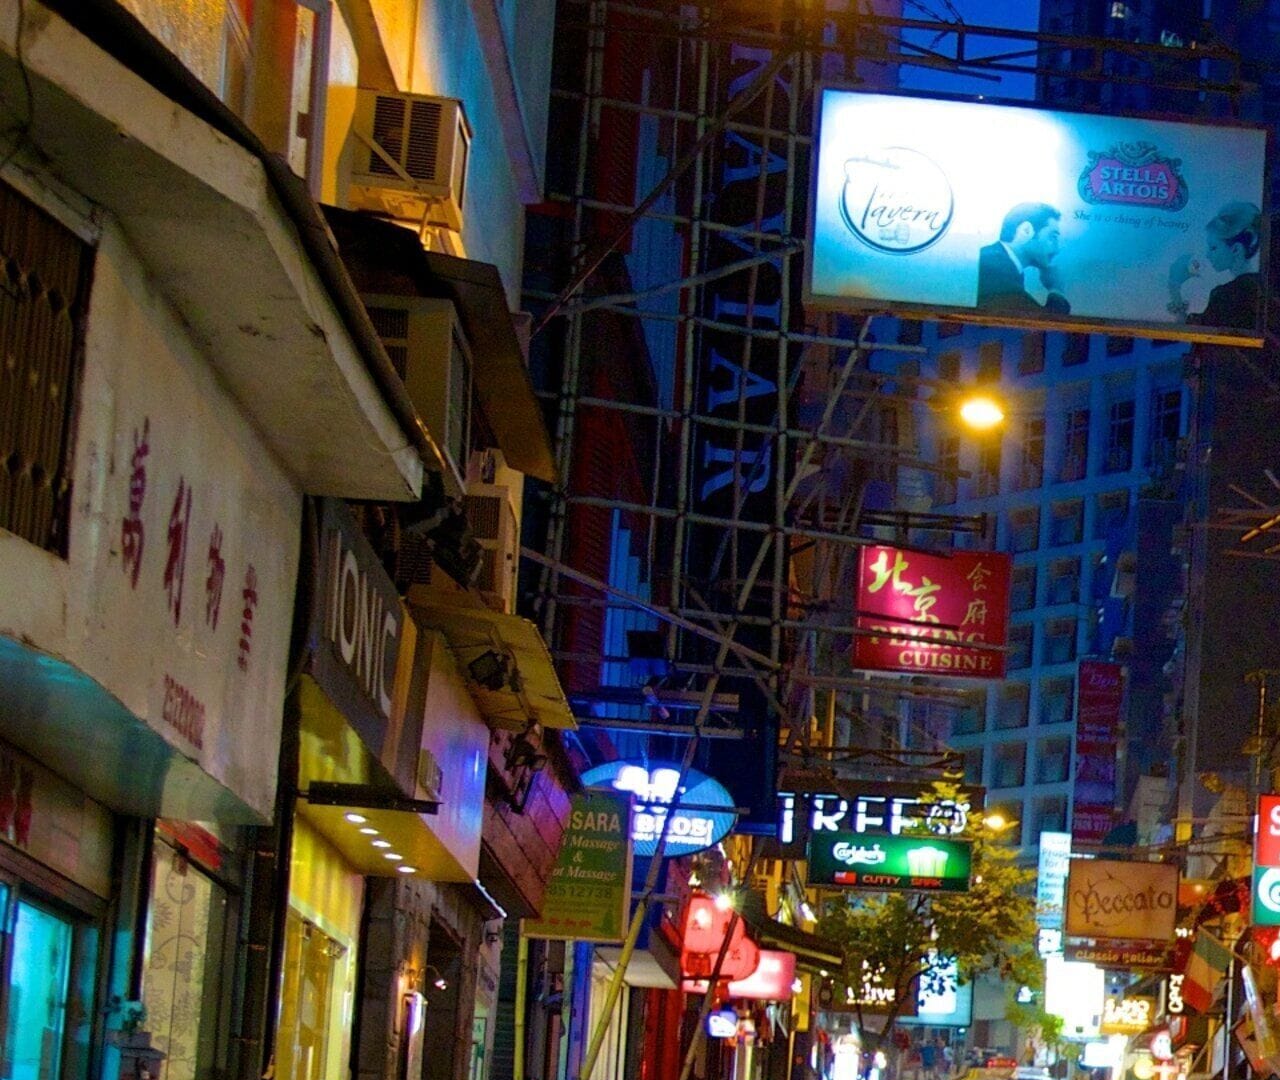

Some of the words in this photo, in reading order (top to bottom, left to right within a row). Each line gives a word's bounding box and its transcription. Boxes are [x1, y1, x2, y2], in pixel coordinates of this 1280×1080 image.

[1100, 166, 1169, 184] STELLA
[1100, 182, 1169, 200] ARTOIS
[868, 551, 941, 624] 北京
[899, 650, 993, 672] CUISINE
[566, 810, 621, 832] SARA
[862, 874, 900, 886] CUTTY
[1074, 885, 1173, 924] Peccato
